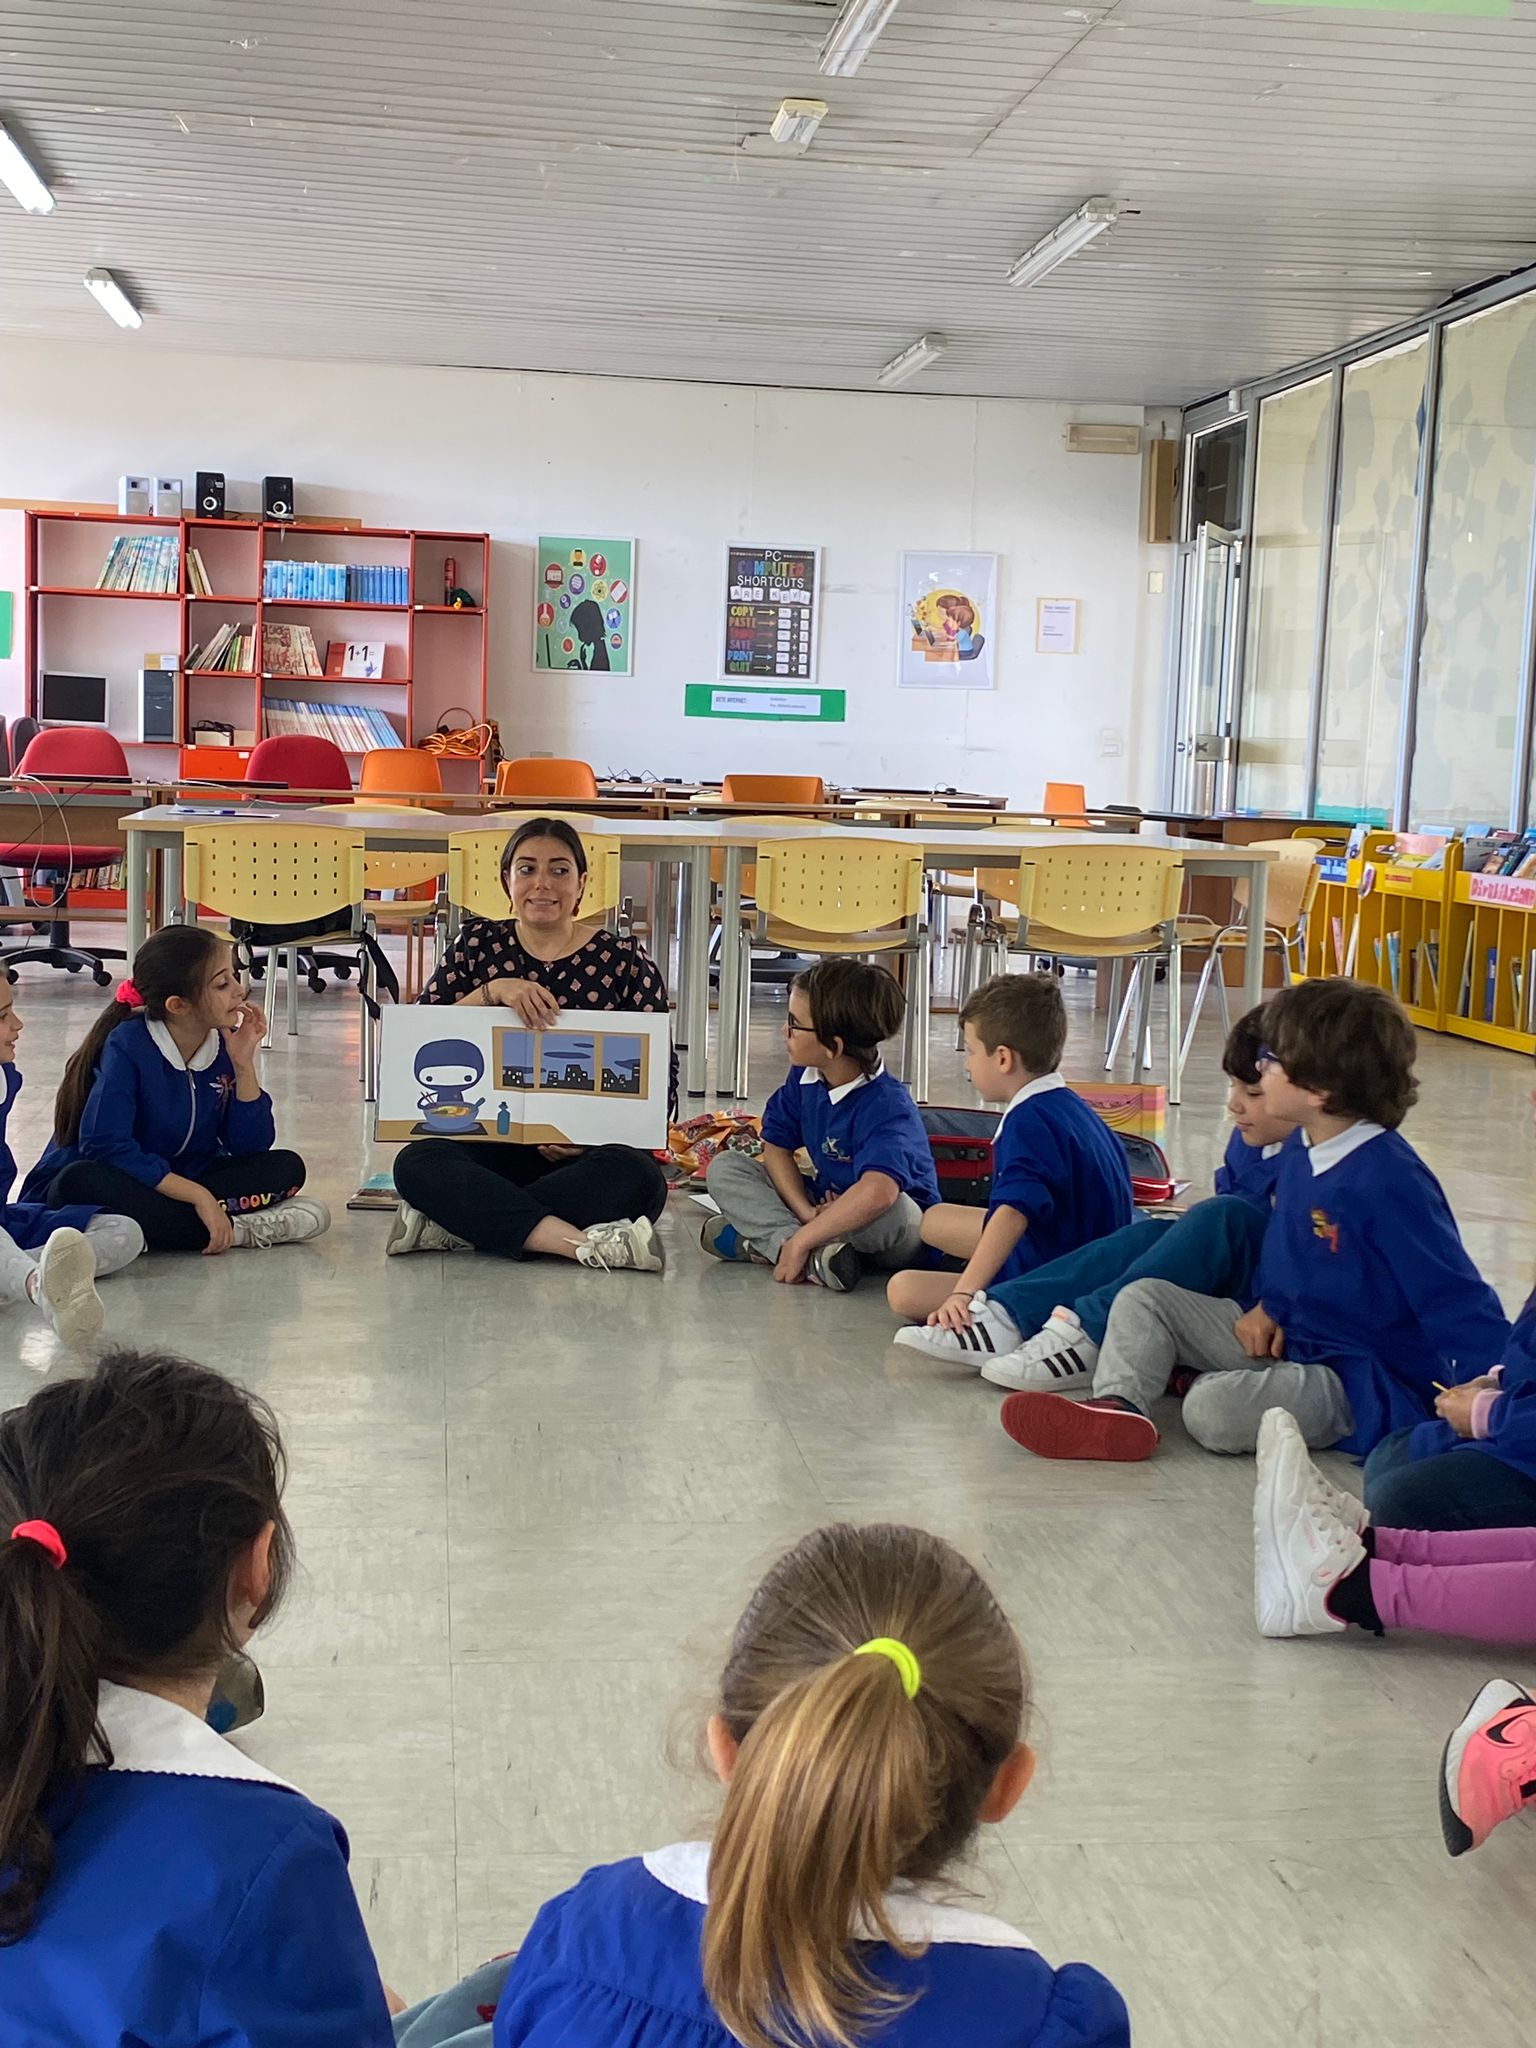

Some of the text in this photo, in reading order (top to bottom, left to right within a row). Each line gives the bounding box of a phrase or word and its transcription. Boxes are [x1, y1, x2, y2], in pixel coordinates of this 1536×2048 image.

[764, 551, 782, 561] PC
[737, 561, 805, 577] COMPUTER
[737, 574, 804, 588] SHORTCUTS
[732, 589, 761, 599] ARE
[731, 606, 755, 617] COPY
[729, 617, 756, 628] PASTE
[729, 639, 752, 650] SAVE
[727, 650, 754, 662] PRINT
[729, 661, 751, 673] QUIT
